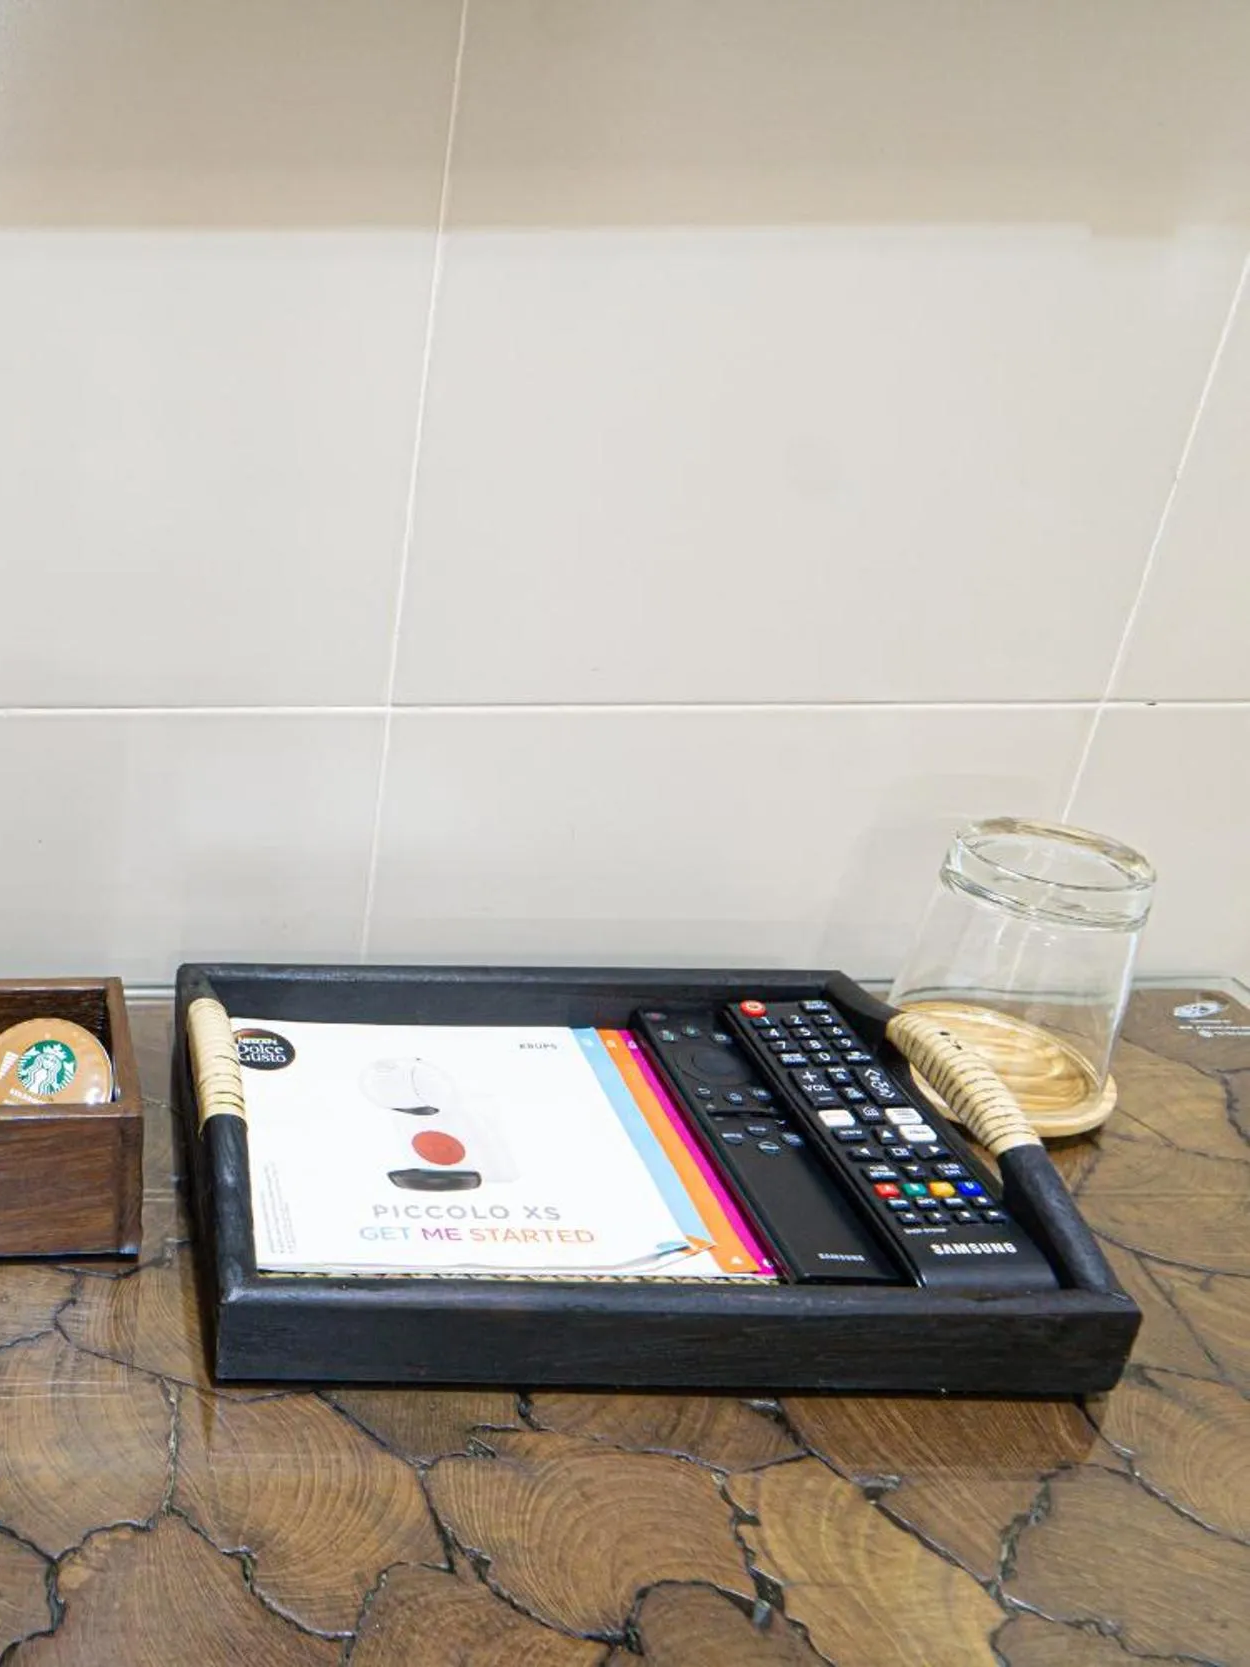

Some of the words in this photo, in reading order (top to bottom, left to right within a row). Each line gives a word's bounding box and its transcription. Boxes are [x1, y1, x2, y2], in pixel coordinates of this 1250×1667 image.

[790, 1014, 803, 1025] 2
[820, 1014, 833, 1024] 3
[769, 1028, 780, 1038] 4
[799, 1026, 811, 1037] 5
[832, 1026, 843, 1036] 6
[776, 1040, 787, 1050] 7
[809, 1039, 822, 1050] 8
[840, 1038, 852, 1048] 9
[817, 1051, 831, 1062] 0
[802, 1084, 831, 1092] VOL
[372, 1204, 510, 1220] PICCOLO
[523, 1205, 561, 1221] XS
[358, 1226, 411, 1241] GET
[421, 1227, 463, 1241] ME
[469, 1227, 596, 1243] STARTED
[929, 1242, 1018, 1256] SAMSUNG
